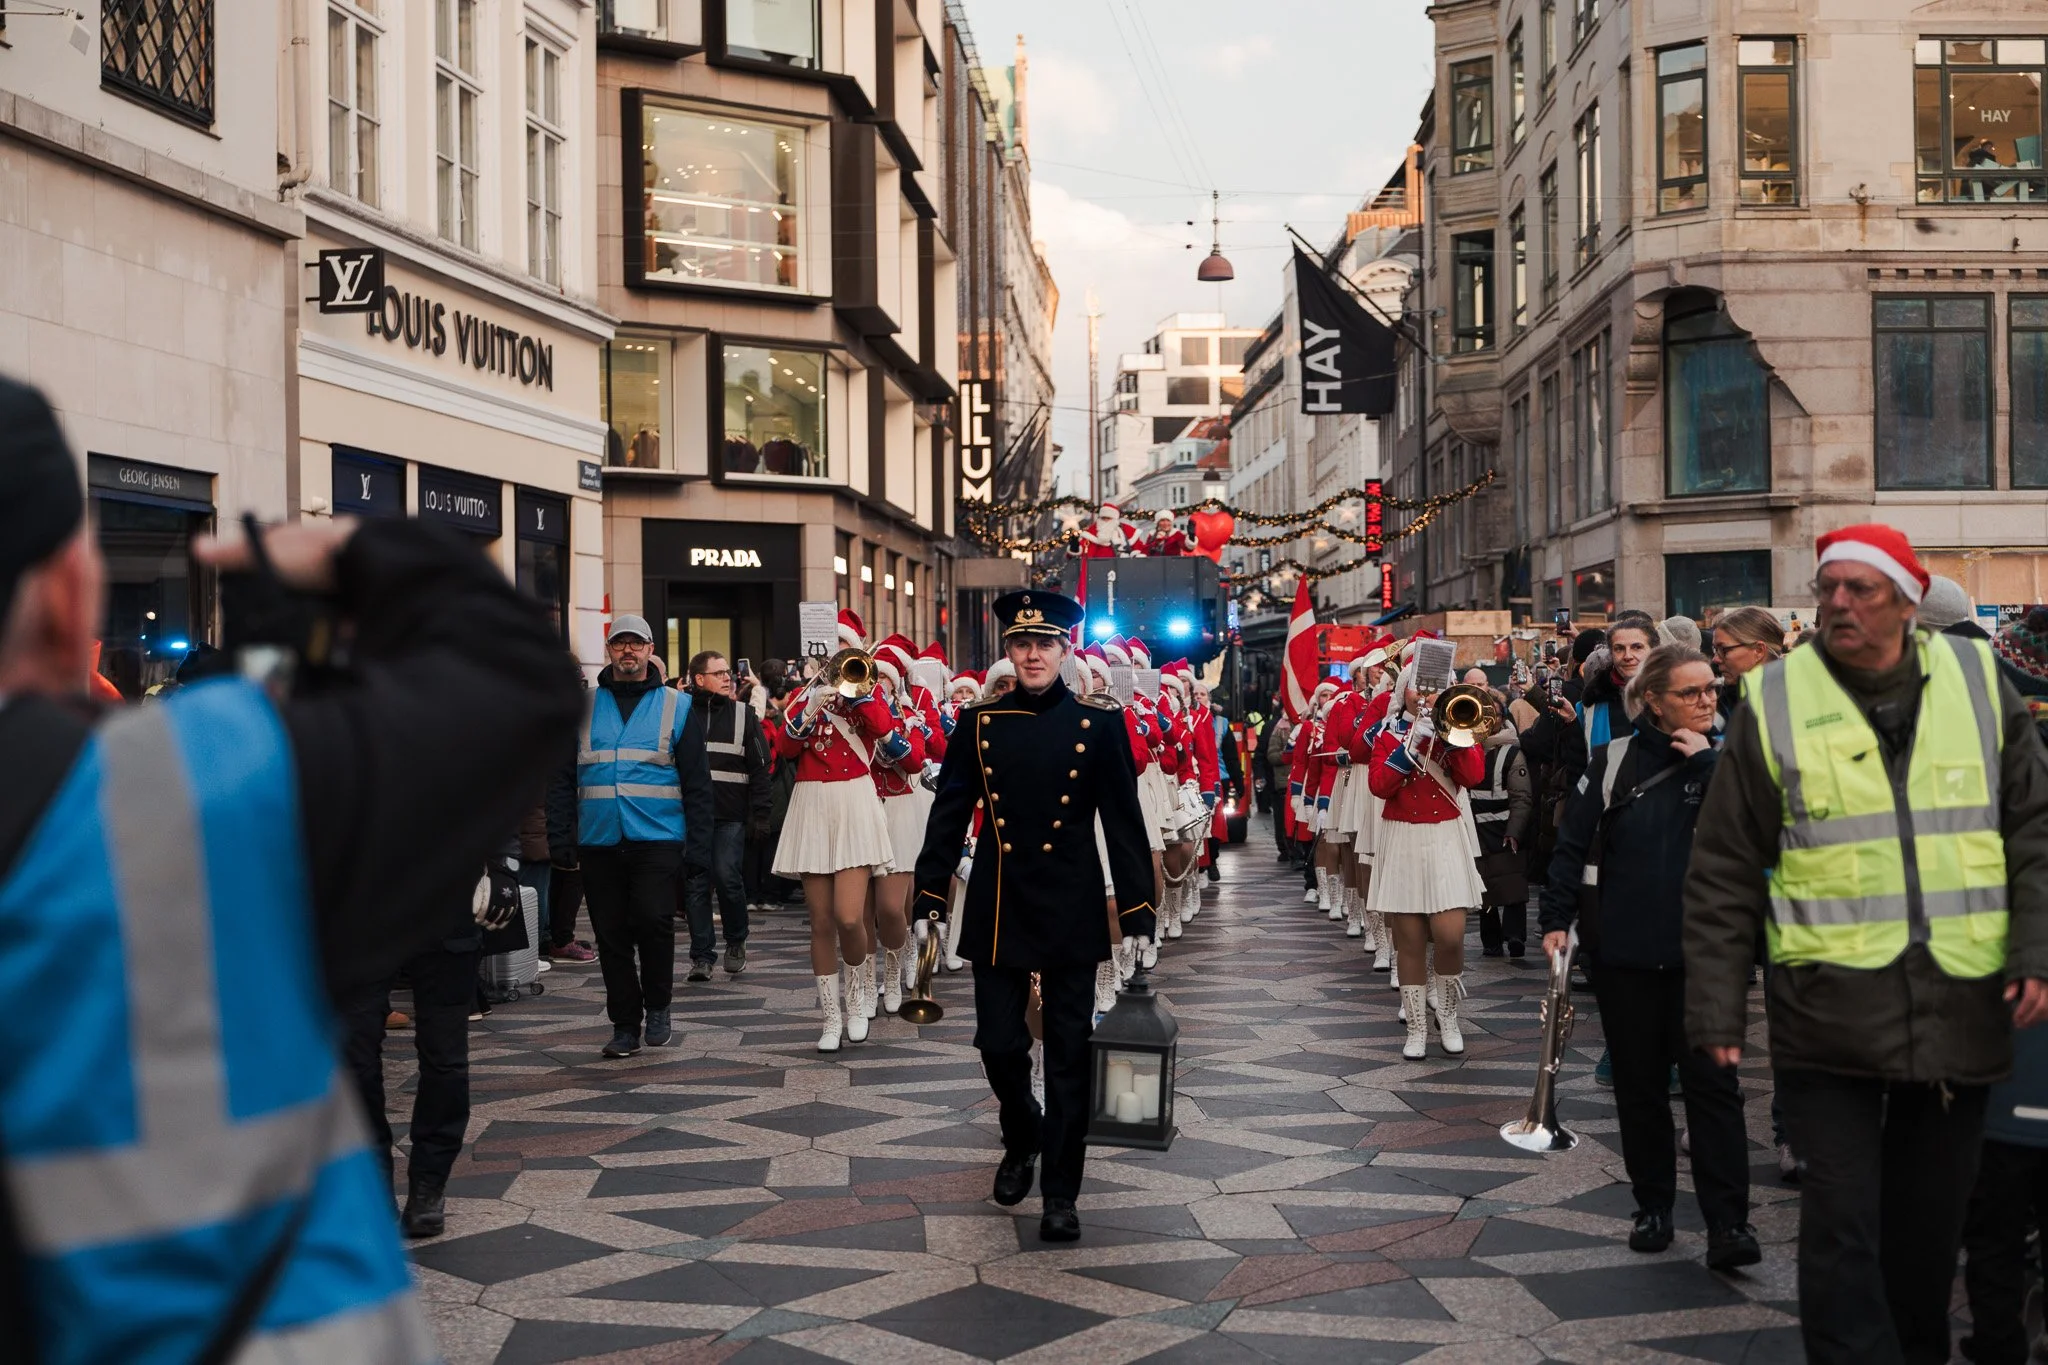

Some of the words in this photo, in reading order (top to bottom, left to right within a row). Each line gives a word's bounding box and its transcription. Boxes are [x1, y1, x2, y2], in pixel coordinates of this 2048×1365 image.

[1981, 109, 2012, 122] HAY
[452, 310, 553, 393] VUITTON
[1304, 318, 1342, 412] HAY
[961, 383, 992, 504] ILLUM
[119, 468, 150, 486] GEORG
[151, 472, 180, 491] JENSEN
[425, 490, 452, 513] LOUIS
[1366, 482, 1382, 523] MMA
[690, 548, 762, 568] PRADA
